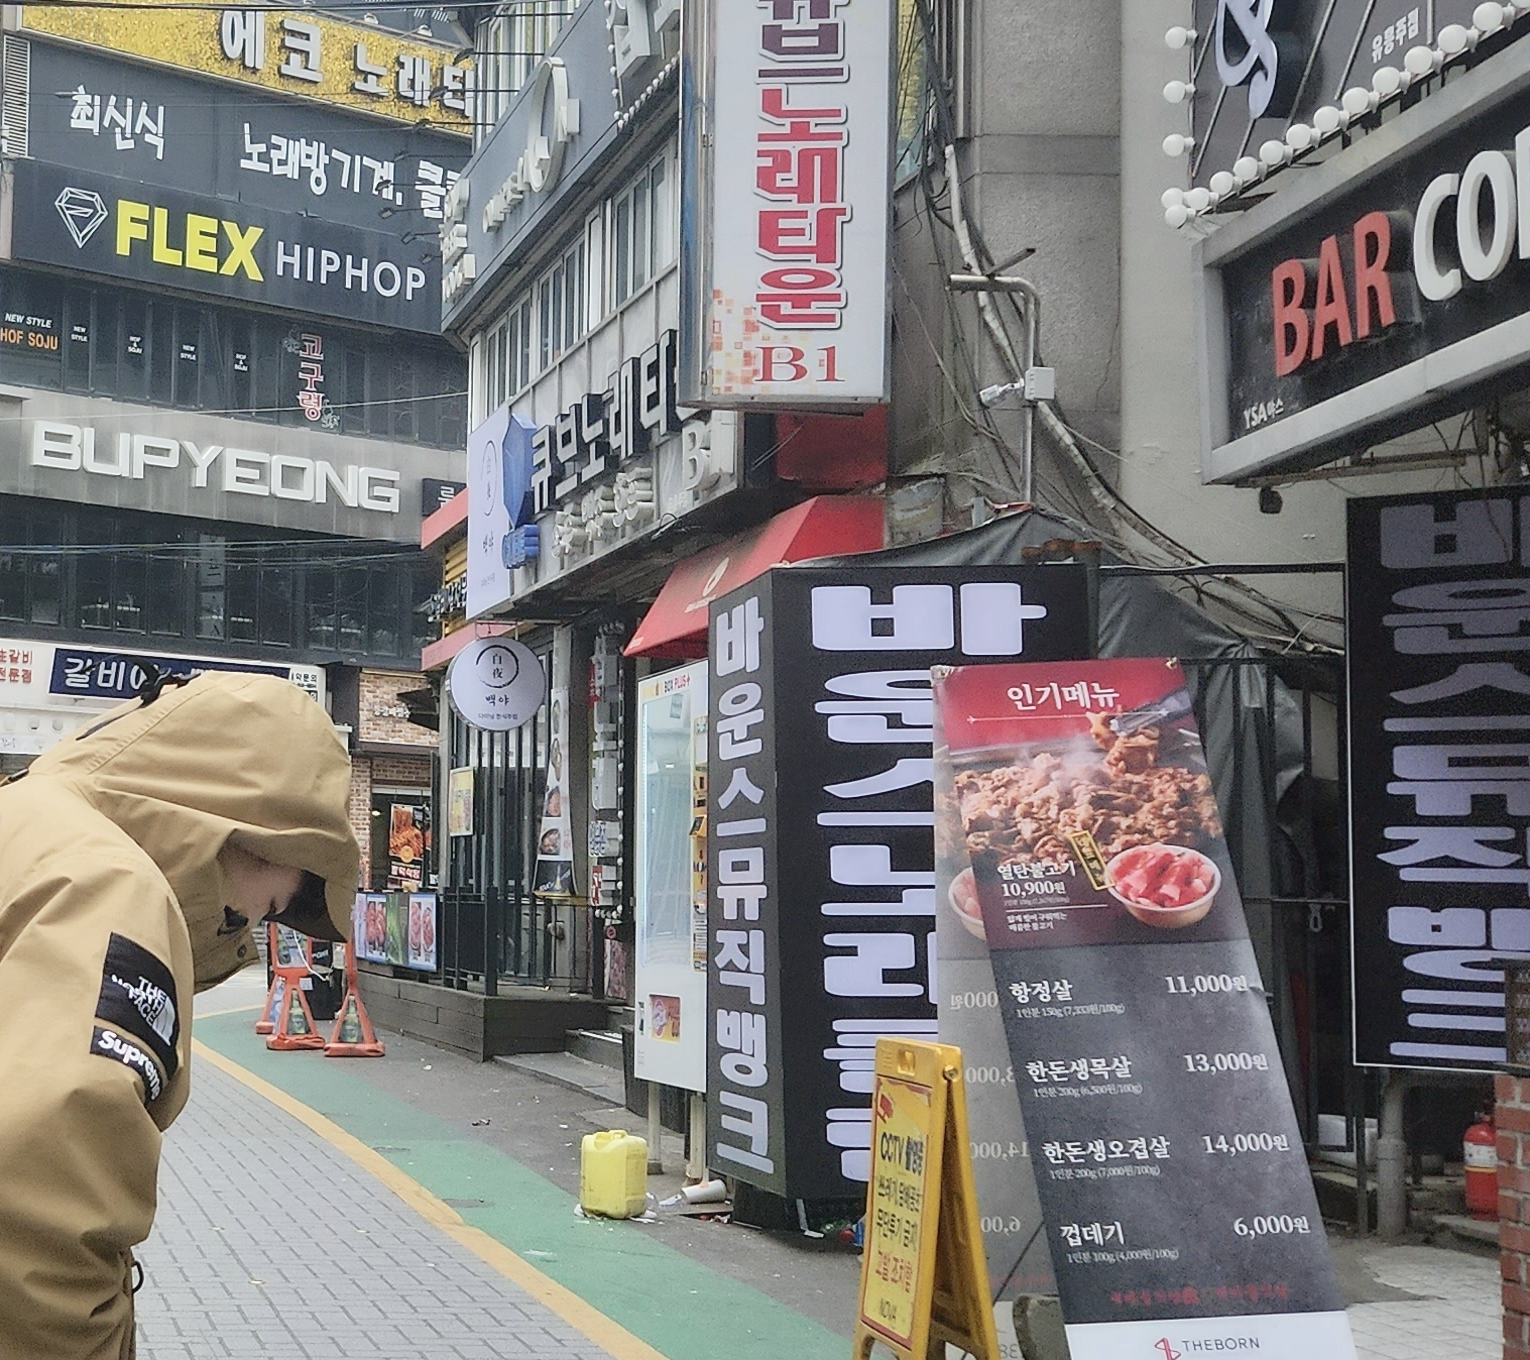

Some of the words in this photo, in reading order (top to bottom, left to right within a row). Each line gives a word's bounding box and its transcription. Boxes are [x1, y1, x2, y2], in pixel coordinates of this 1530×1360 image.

[219, 6, 324, 84] 에코
[70, 84, 166, 160] 최신식
[115, 197, 266, 283] FLEX
[275, 240, 427, 302] HIPHOP
[1270, 209, 1396, 378] BAR
[4, 312, 24, 325] NEW
[25, 314, 54, 330] STYLE
[0, 326, 23, 346] HOF
[27, 330, 59, 352] SOJU
[754, 344, 846, 384] B1
[30, 419, 402, 514] BUPYEONG
[1005, 681, 1121, 713] 인기메뉴
[714, 595, 775, 1176] 바운스뮤직뱅크
[996, 859, 1077, 881] 열탄불고기
[1001, 880, 1067, 899] 10,900원
[137, 975, 168, 1002] THE
[1007, 978, 1074, 1003] 항정살
[1164, 973, 1249, 998] 11,000원
[128, 990, 156, 1027] FACE
[1024, 1053, 1133, 1082] 한돈생목살
[1183, 1051, 1270, 1075] 13,000원
[879, 1130, 904, 1168] CCTV
[1042, 1133, 1172, 1165] 한돈생오겹살
[1201, 1131, 1290, 1156] 14,000원
[1060, 1220, 1126, 1248] 껍데기
[1232, 1213, 1311, 1238] 6,000원
[1181, 1336, 1262, 1354] THEBORN
